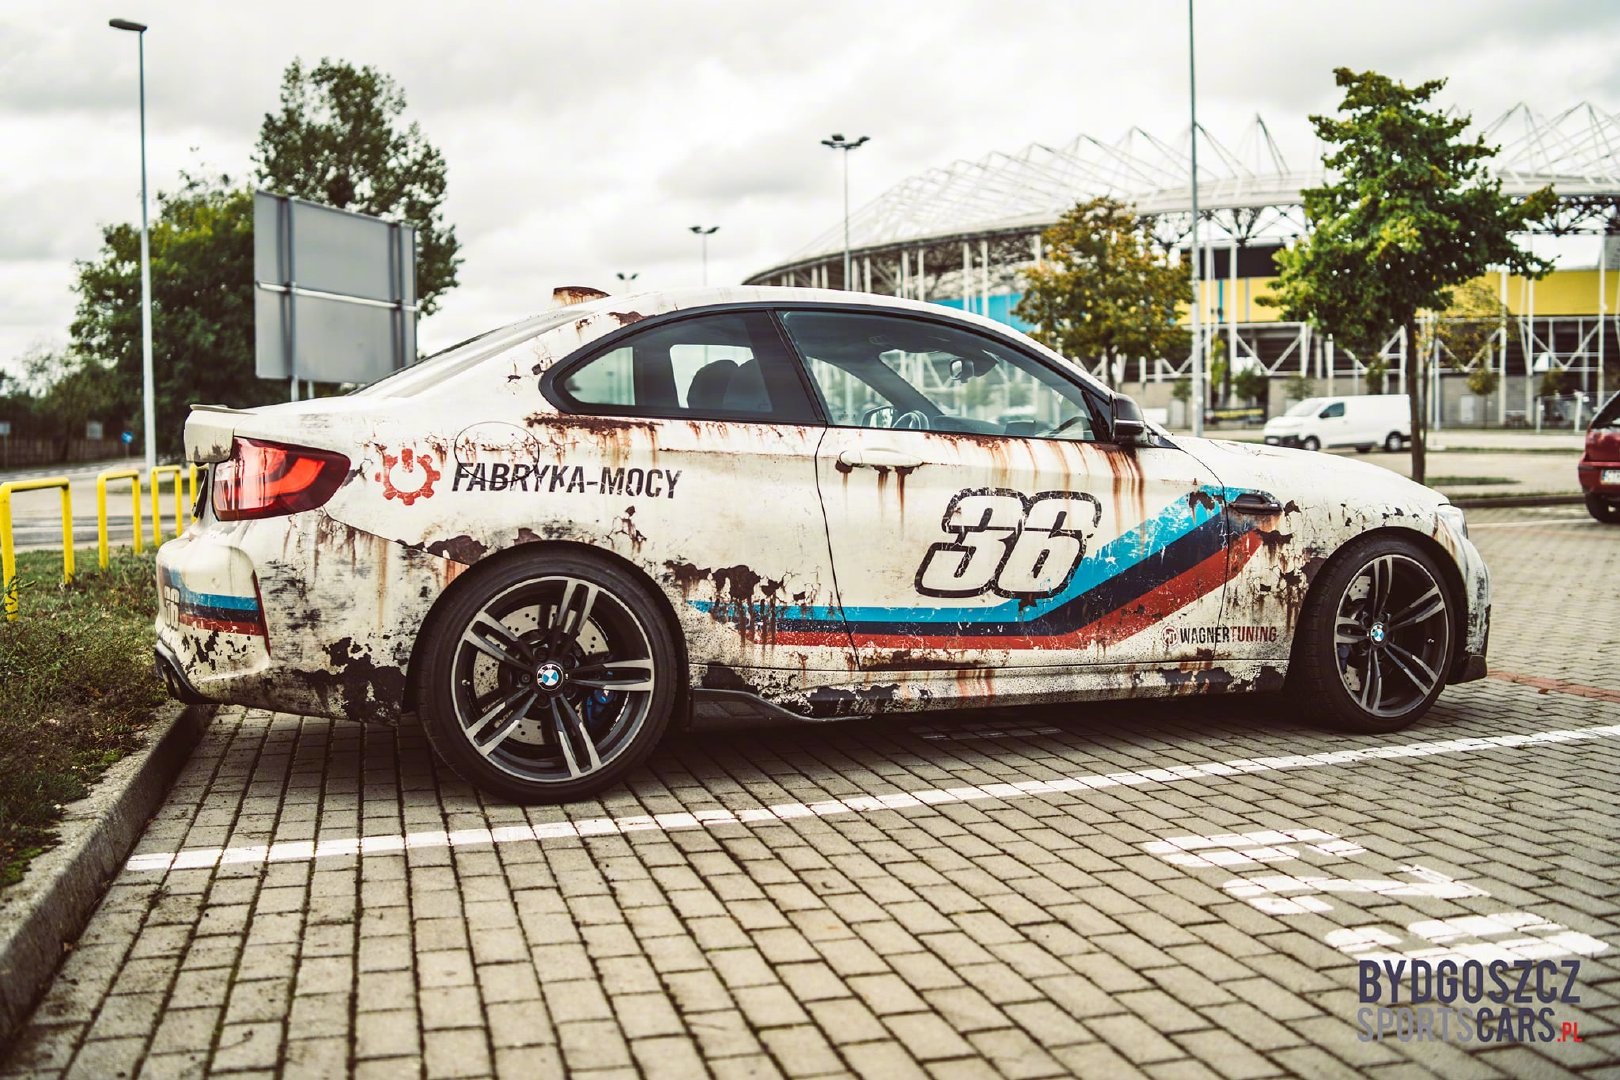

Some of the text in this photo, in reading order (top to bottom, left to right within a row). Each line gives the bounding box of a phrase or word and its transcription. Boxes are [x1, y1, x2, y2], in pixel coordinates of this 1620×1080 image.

[452, 462, 682, 499] FABRYKA-MOCY
[914, 486, 1102, 599] 36
[1180, 626, 1277, 644] WAGNERTUNING
